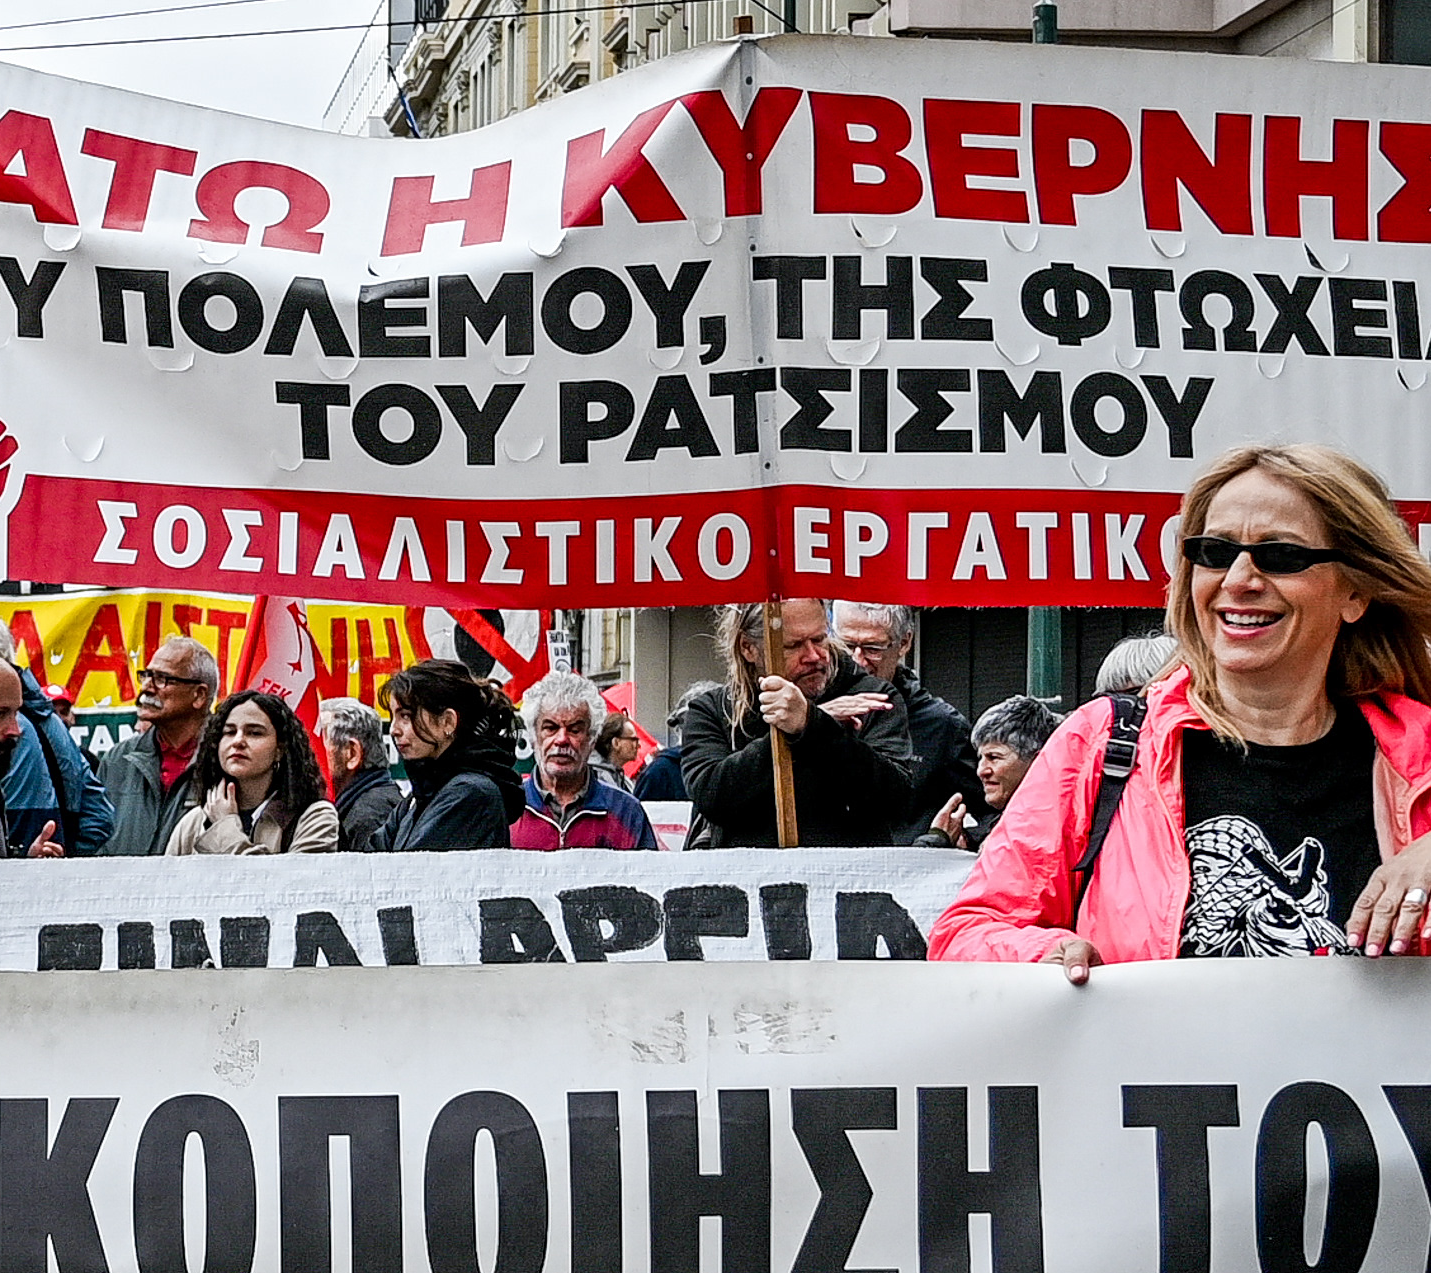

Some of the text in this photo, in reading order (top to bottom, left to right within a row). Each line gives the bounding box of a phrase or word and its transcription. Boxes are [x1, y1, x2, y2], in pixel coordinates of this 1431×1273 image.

[381, 160, 511, 257] Η
[96, 259, 728, 365] ΠΟΛΕΜΟΥ,
[752, 255, 993, 342] ΤΗΣ
[275, 366, 1216, 467] ΤΟΥ ΡΑΤΣΙΣΜΟΥ
[92, 499, 1175, 586] ΣΟΣΙΑΛΙΣΤΙΚΟ ΕΡΓΑΤΙΚ
